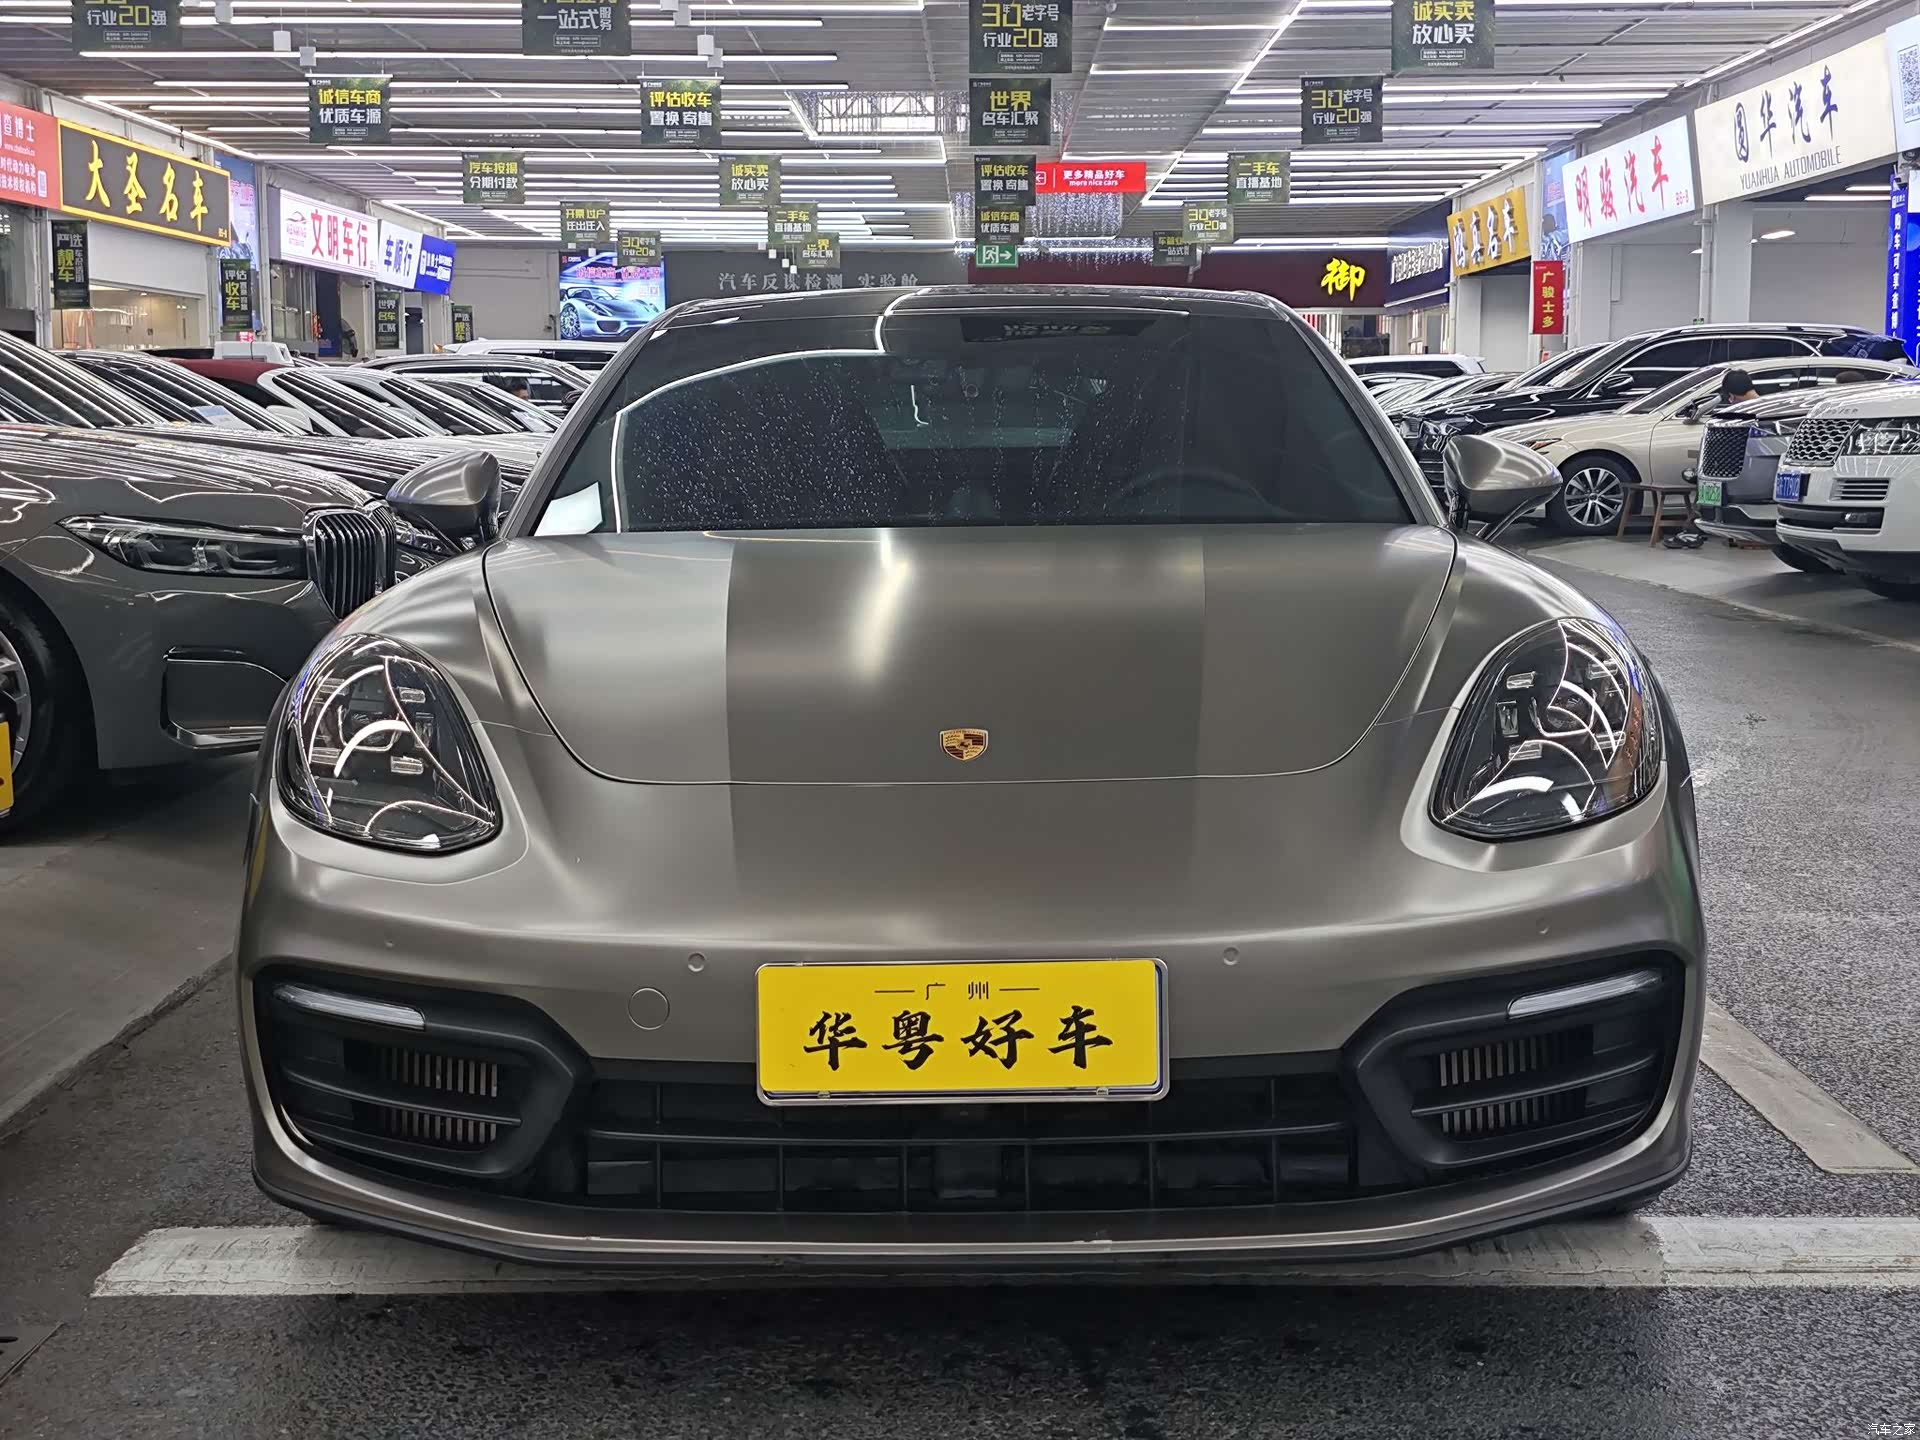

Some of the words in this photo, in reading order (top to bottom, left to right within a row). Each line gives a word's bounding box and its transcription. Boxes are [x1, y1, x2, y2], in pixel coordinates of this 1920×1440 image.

[87, 5, 167, 26] 行业20强
[537, 6, 612, 31] 一站式服务
[1413, 1, 1475, 21] 诚实卖
[983, 28, 1058, 48] 行业20强
[1412, 24, 1475, 44] 放心买
[319, 89, 381, 105] 诚信车商
[650, 91, 712, 108] 评估收车
[990, 91, 1031, 112] 世界
[319, 108, 381, 124] 优质车源
[650, 111, 679, 126] 置换
[682, 111, 712, 126] 寄售
[982, 111, 1039, 126] 名车汇聚
[1312, 108, 1372, 125] 行业20强
[981, 165, 1028, 176] 评估收车
[1063, 169, 1125, 180] 更多精品好车
[1239, 161, 1280, 176] 二手车
[1739, 165, 1780, 190] YUANHUA
[1783, 145, 1842, 180] AUTOMOBILE
[84, 140, 209, 232] 大圣名车
[469, 176, 518, 189] 分期付款
[731, 178, 769, 190] 放心买
[1088, 179, 1103, 187] nice
[1236, 176, 1282, 189] 直播基地
[776, 210, 810, 222] 二手车
[56, 233, 83, 248] 严选
[311, 209, 368, 267] 文明车行
[57, 248, 75, 283] 靓车
[225, 281, 240, 311] 收车
[925, 981, 990, 1001] 广州
[803, 1005, 1114, 1071] 华粤好车
